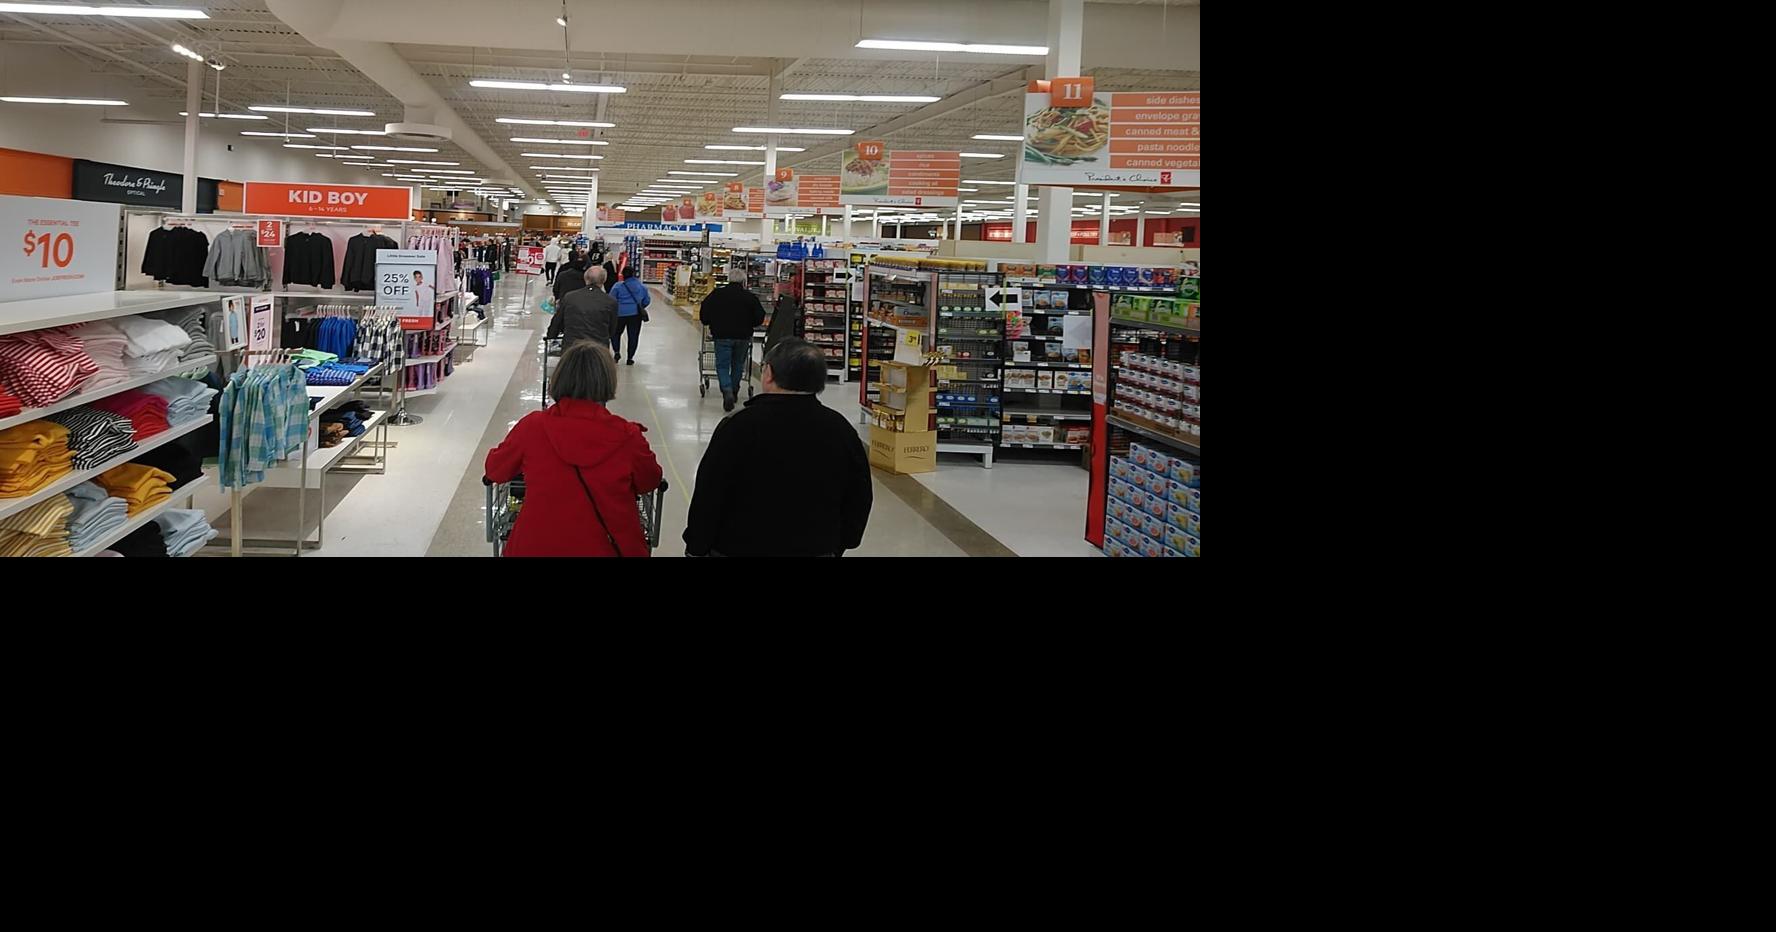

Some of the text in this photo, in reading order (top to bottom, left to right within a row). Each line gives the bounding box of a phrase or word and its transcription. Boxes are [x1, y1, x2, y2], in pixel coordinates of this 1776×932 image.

[1064, 83, 1082, 100] 11
[1146, 95, 1167, 105] side
[1135, 112, 1180, 121] envelope
[1125, 127, 1162, 136] canned
[1163, 128, 1189, 136] meat
[864, 145, 879, 156] 10
[1137, 143, 1164, 153] pasta
[1126, 158, 1163, 167] canned
[103, 173, 136, 188] Theodore
[142, 177, 166, 194] Pringle
[288, 190, 369, 206] KID BOY
[627, 223, 682, 231] PHARMACY
[23, 229, 74, 268] $10
[383, 273, 410, 284] 25%
[383, 285, 410, 295] OFF
[254, 328, 266, 341] $20
